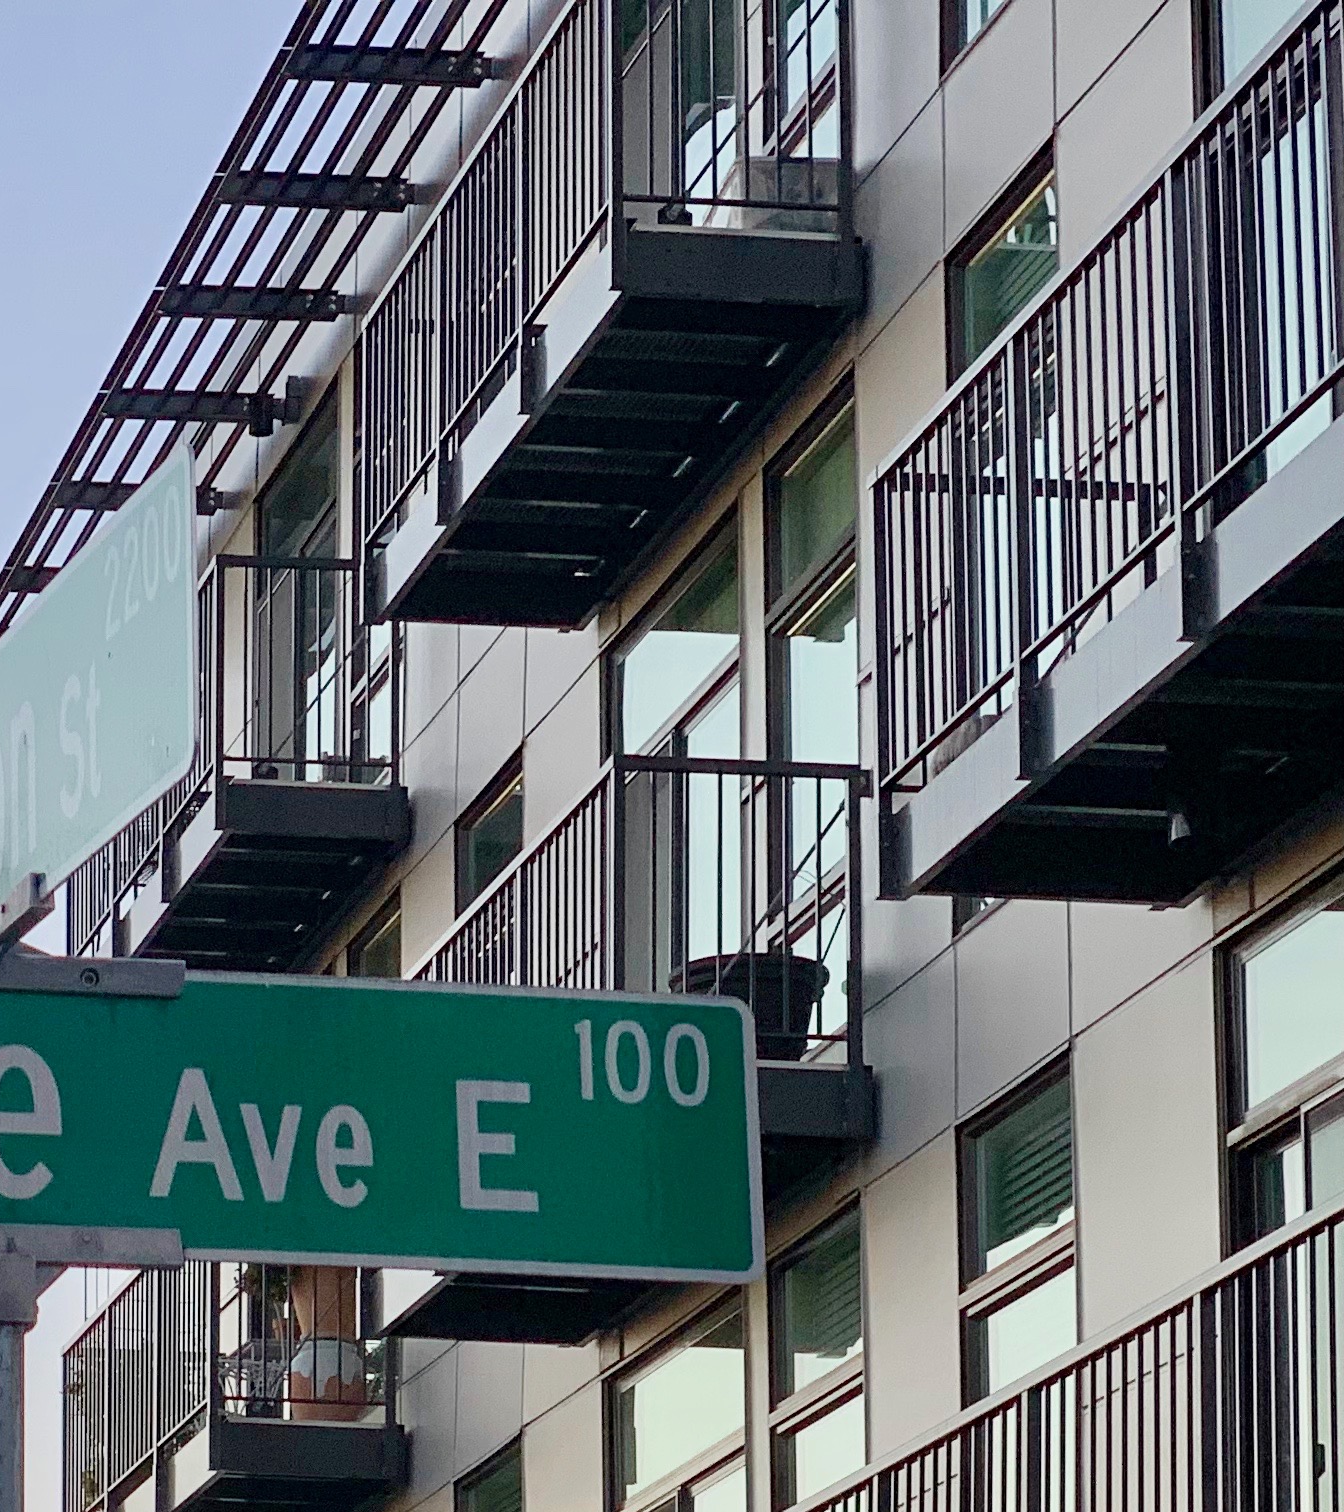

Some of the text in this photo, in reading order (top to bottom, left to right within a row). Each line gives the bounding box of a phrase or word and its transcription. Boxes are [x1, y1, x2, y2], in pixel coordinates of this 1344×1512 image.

[104, 484, 180, 641] 2200
[59, 662, 102, 820] St
[573, 1018, 711, 1107] 100
[148, 1066, 375, 1208] Ave
[454, 1078, 540, 1213] E
